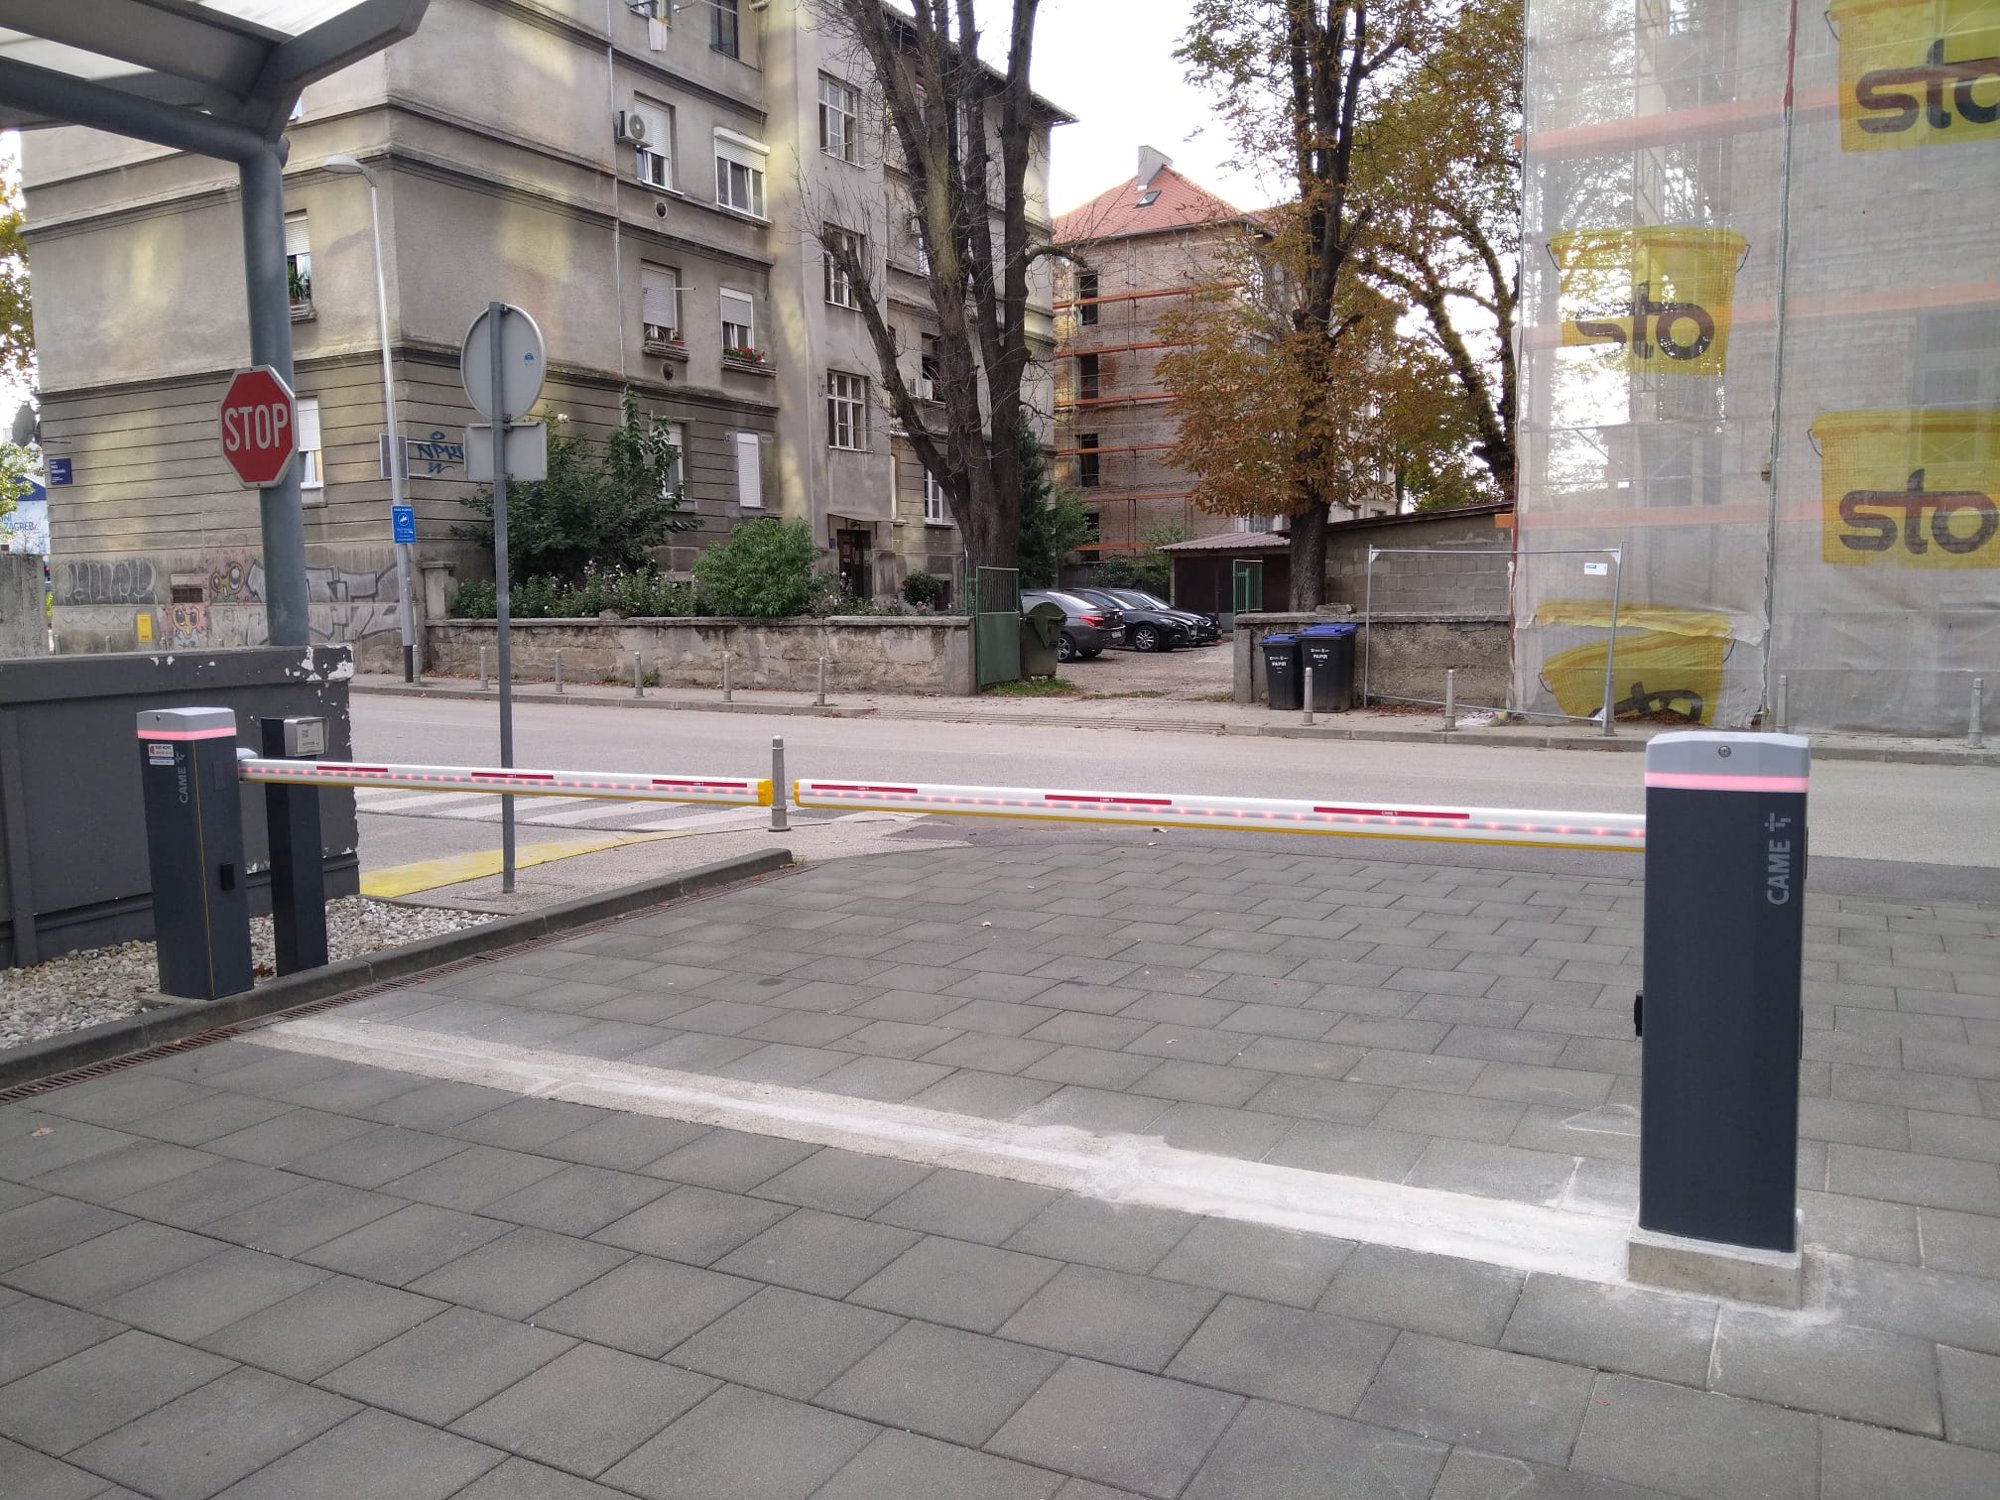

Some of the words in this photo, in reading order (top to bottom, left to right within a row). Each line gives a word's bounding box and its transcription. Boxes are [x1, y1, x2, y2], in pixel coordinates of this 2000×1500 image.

[1575, 280, 1716, 361] sto
[224, 403, 288, 452] STOP
[1839, 468, 2000, 555] sto
[178, 766, 189, 804] CAME
[1767, 839, 1791, 905] CAME
